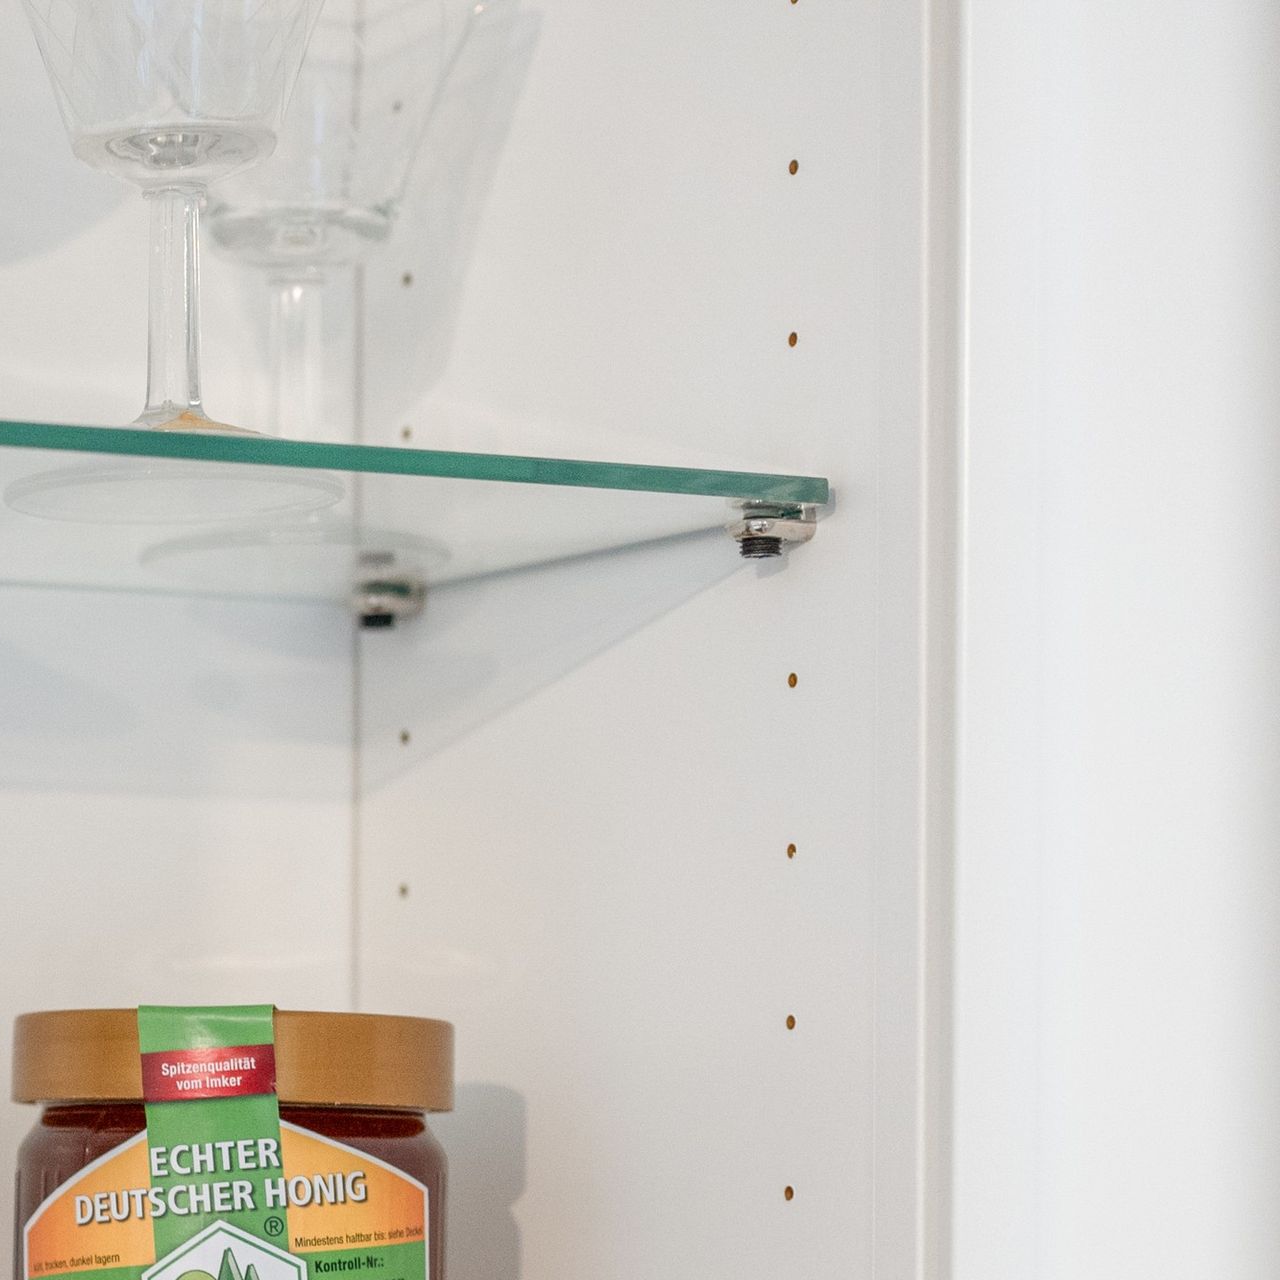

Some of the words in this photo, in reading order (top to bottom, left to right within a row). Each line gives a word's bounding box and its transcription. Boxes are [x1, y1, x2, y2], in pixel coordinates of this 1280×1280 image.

[161, 1057, 256, 1077] Spitzenqualität
[176, 1078, 202, 1091] vom
[206, 1074, 242, 1088] Imker
[150, 1137, 281, 1177] ECHTER
[75, 1179, 256, 1226] DEUTSCHER
[264, 1170, 367, 1208] HONIG
[294, 1234, 343, 1248] Mindestens
[346, 1232, 372, 1244] haltbar
[374, 1231, 387, 1242] bis:
[70, 1255, 93, 1266] dunkel
[95, 1253, 120, 1265] lagern
